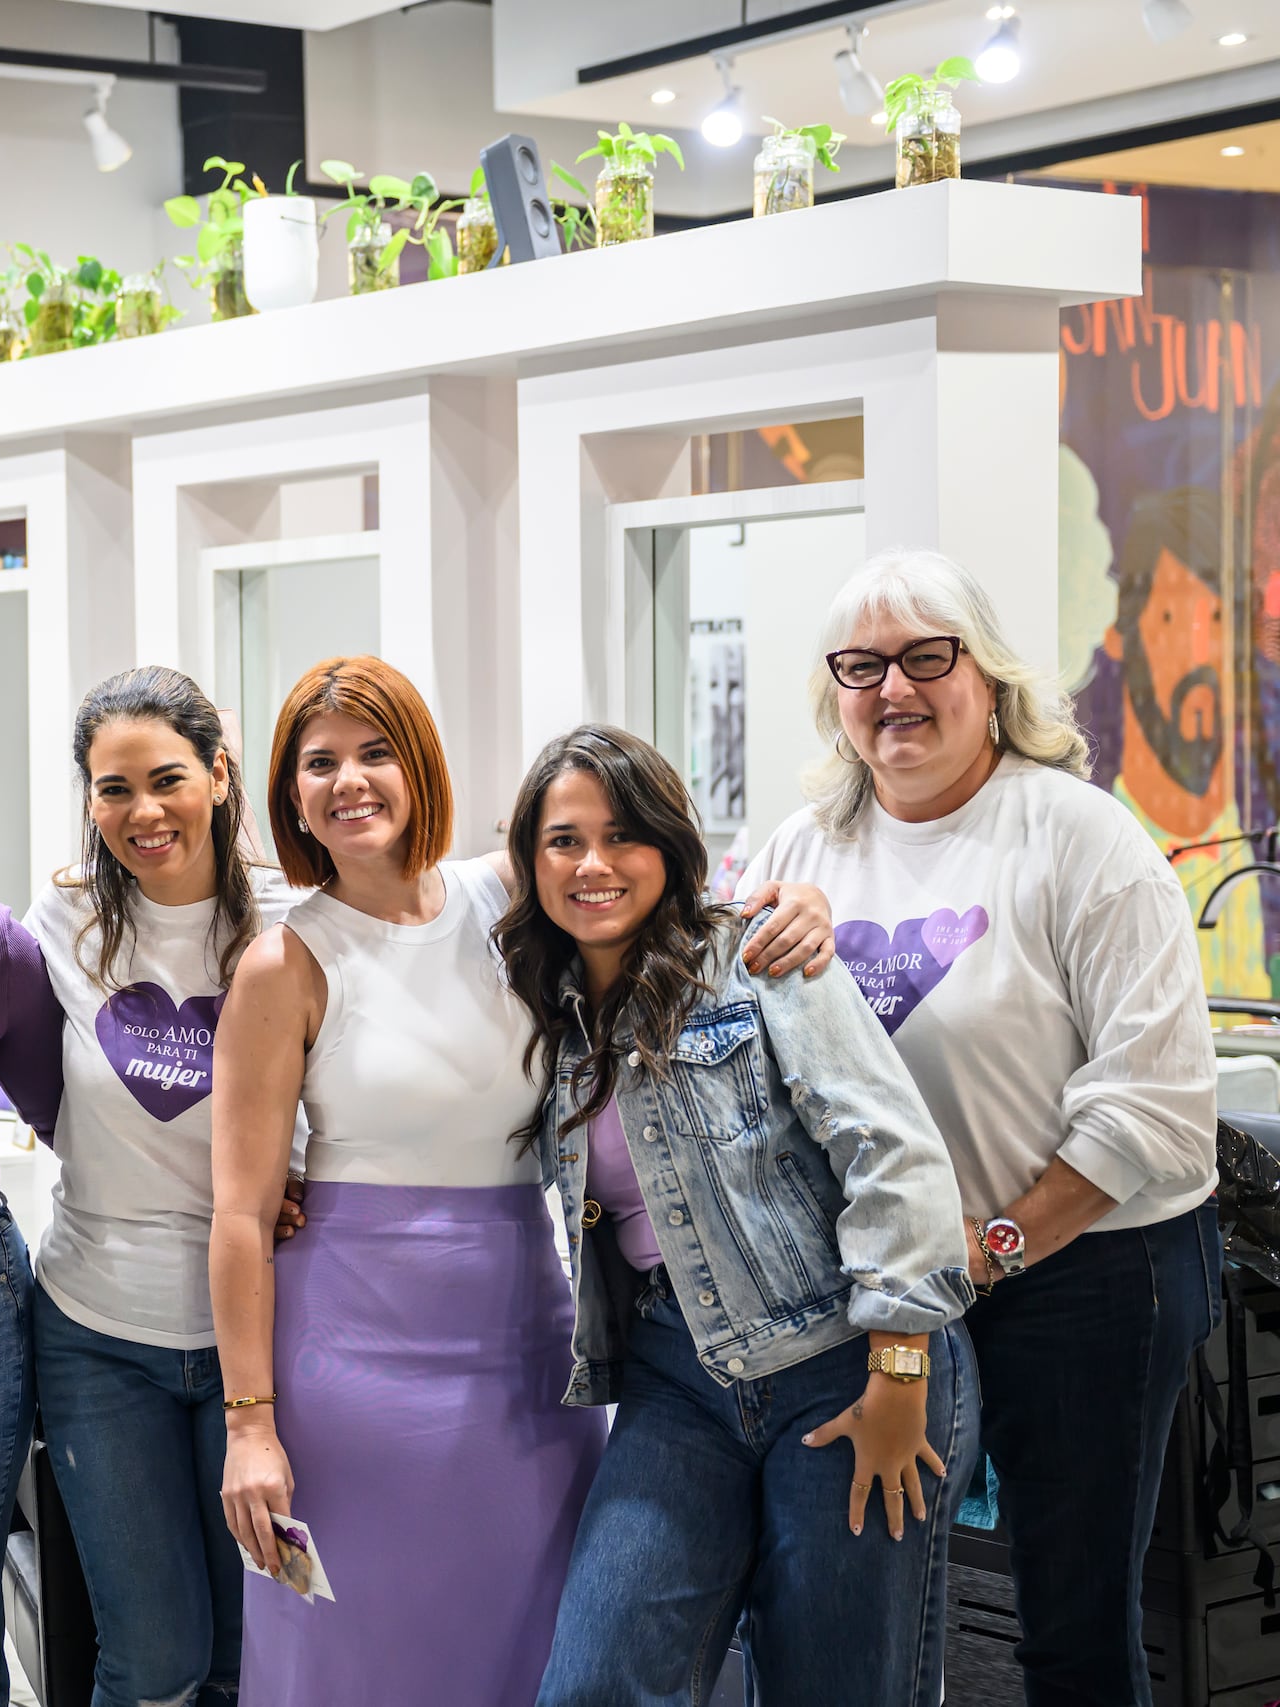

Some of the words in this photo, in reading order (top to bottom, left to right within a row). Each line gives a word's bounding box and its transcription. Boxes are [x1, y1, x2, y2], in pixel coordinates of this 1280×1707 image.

[1132, 314, 1261, 420] JUAN
[868, 953, 922, 974] AMOR
[123, 1024, 160, 1039] SOLO
[162, 1026, 216, 1046] AMO
[147, 1042, 180, 1058] PARA
[184, 1049, 198, 1060] TI
[125, 1058, 208, 1091] mujer
